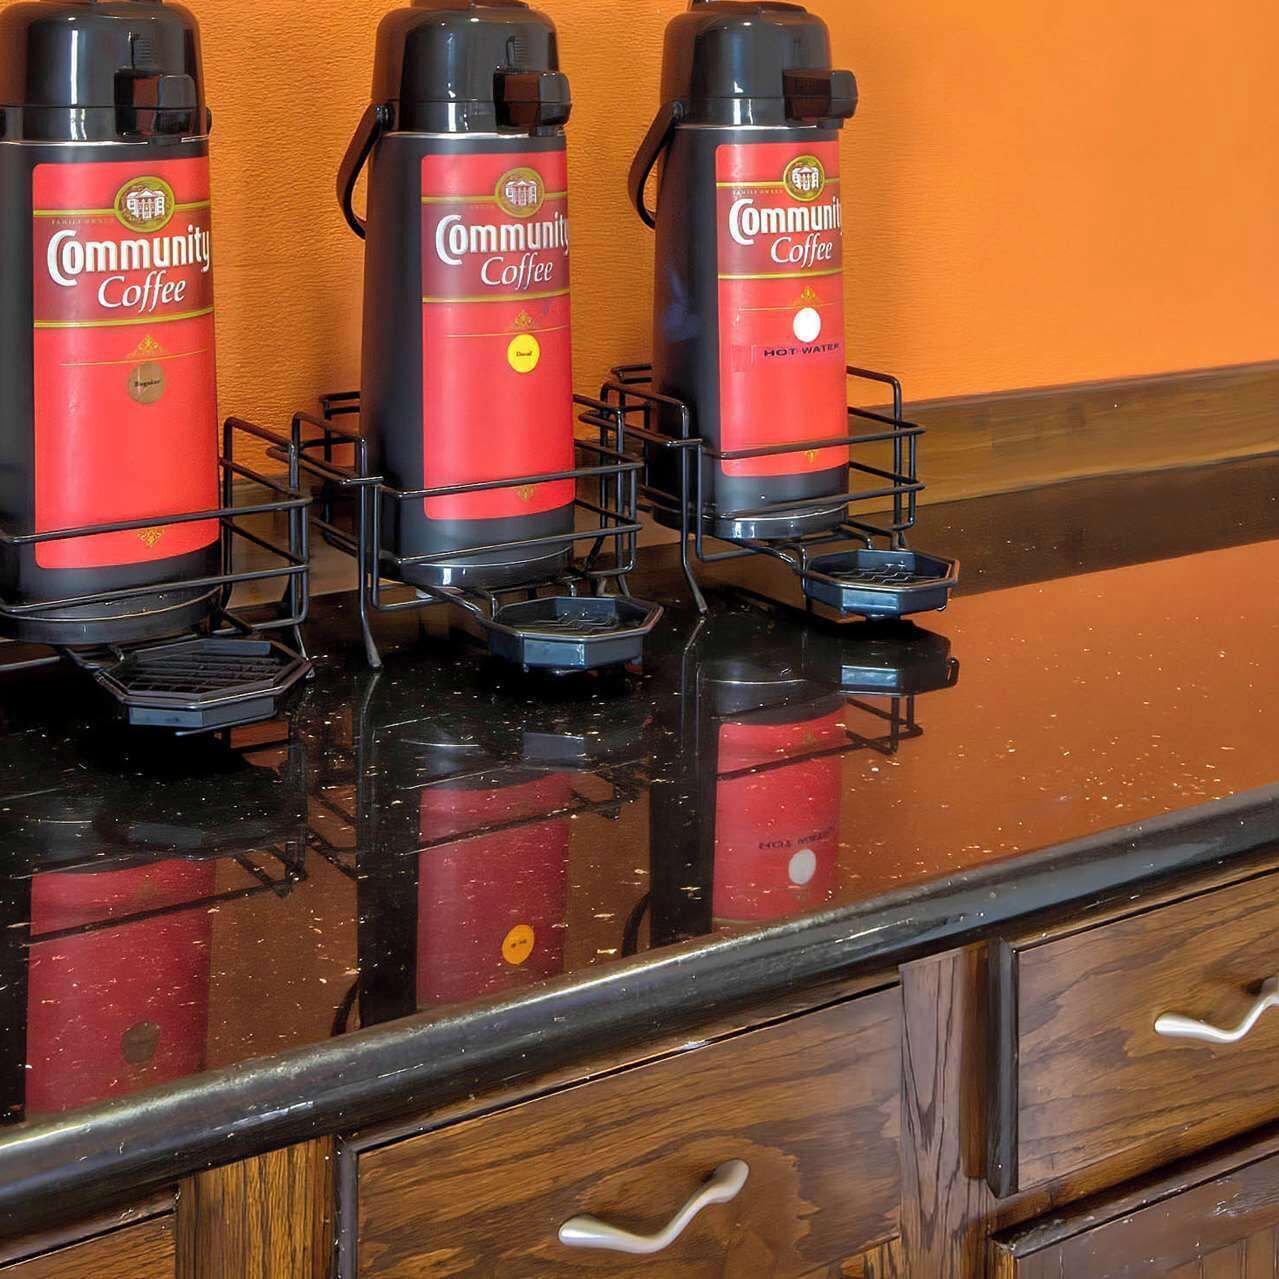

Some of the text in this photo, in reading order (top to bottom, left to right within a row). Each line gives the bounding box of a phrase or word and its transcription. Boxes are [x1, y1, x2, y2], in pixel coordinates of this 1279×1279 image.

[728, 195, 843, 246] Communit
[46, 223, 211, 287] Community
[480, 251, 554, 291] Coffee
[770, 231, 833, 269] Coffee
[97, 268, 187, 314] Coffee
[764, 343, 840, 357] HOT WATER
